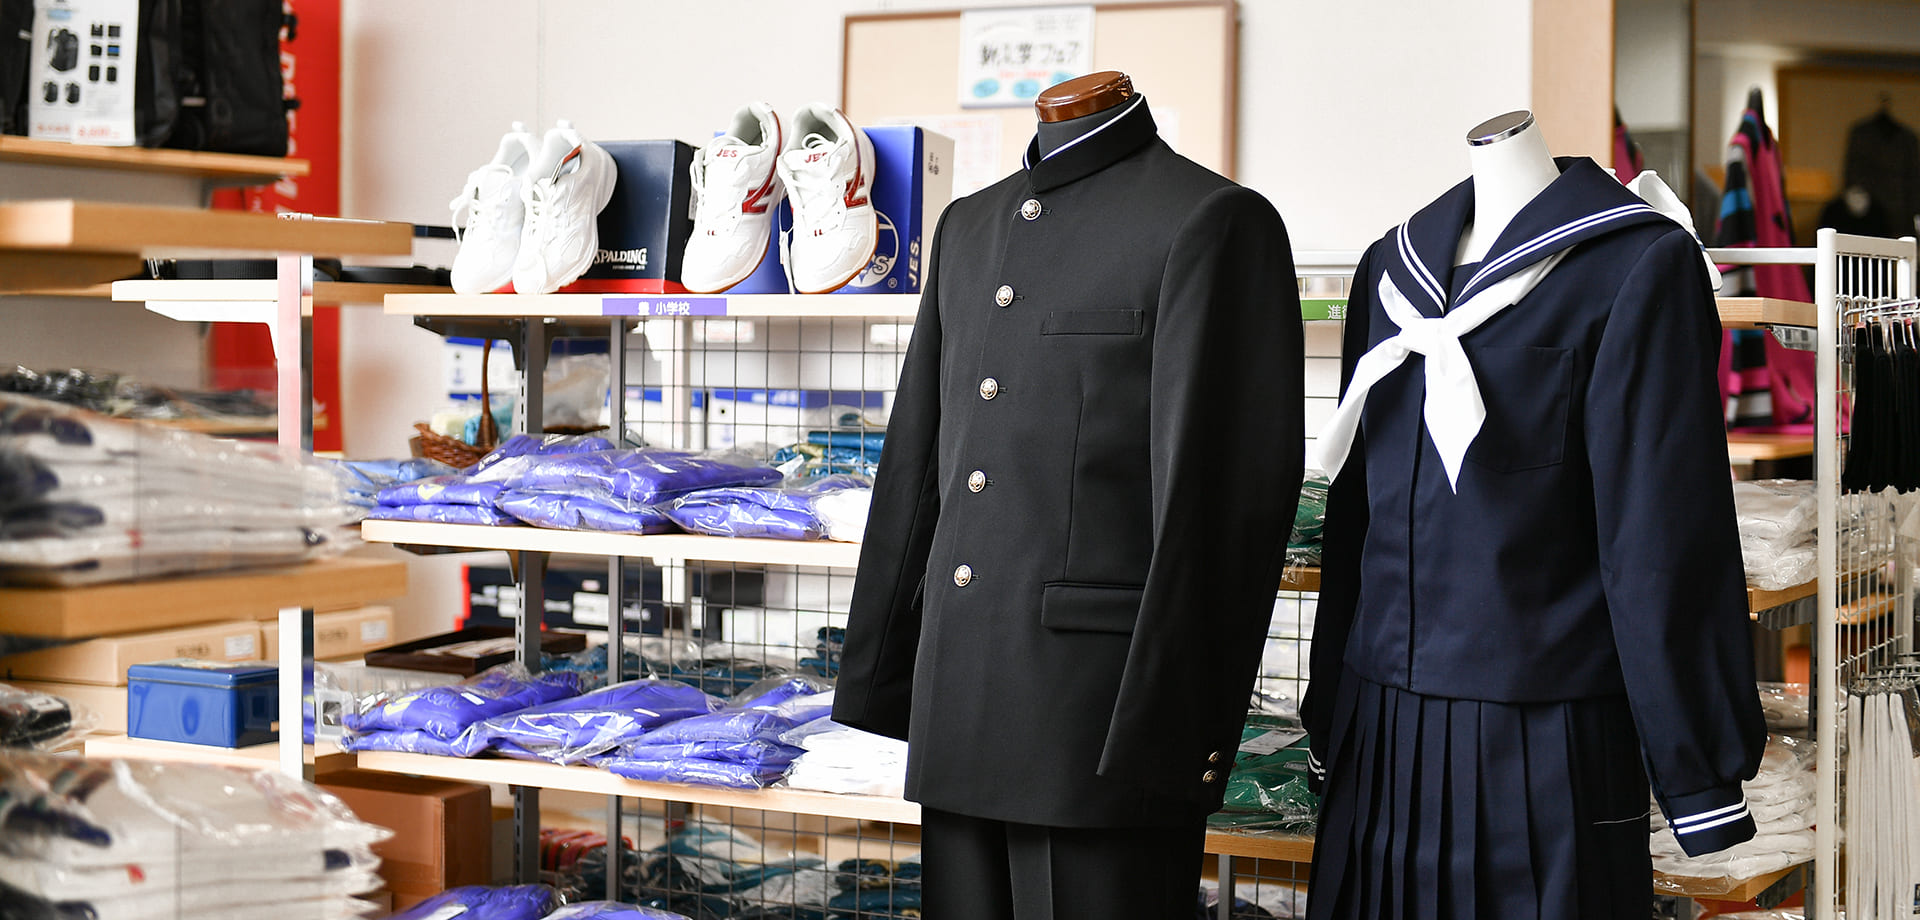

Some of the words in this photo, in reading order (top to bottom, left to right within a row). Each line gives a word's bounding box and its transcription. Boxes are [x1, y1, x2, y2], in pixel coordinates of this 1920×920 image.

[716, 148, 738, 158] JES
[594, 248, 648, 265] SPALDING
[655, 301, 690, 316] 小学校
